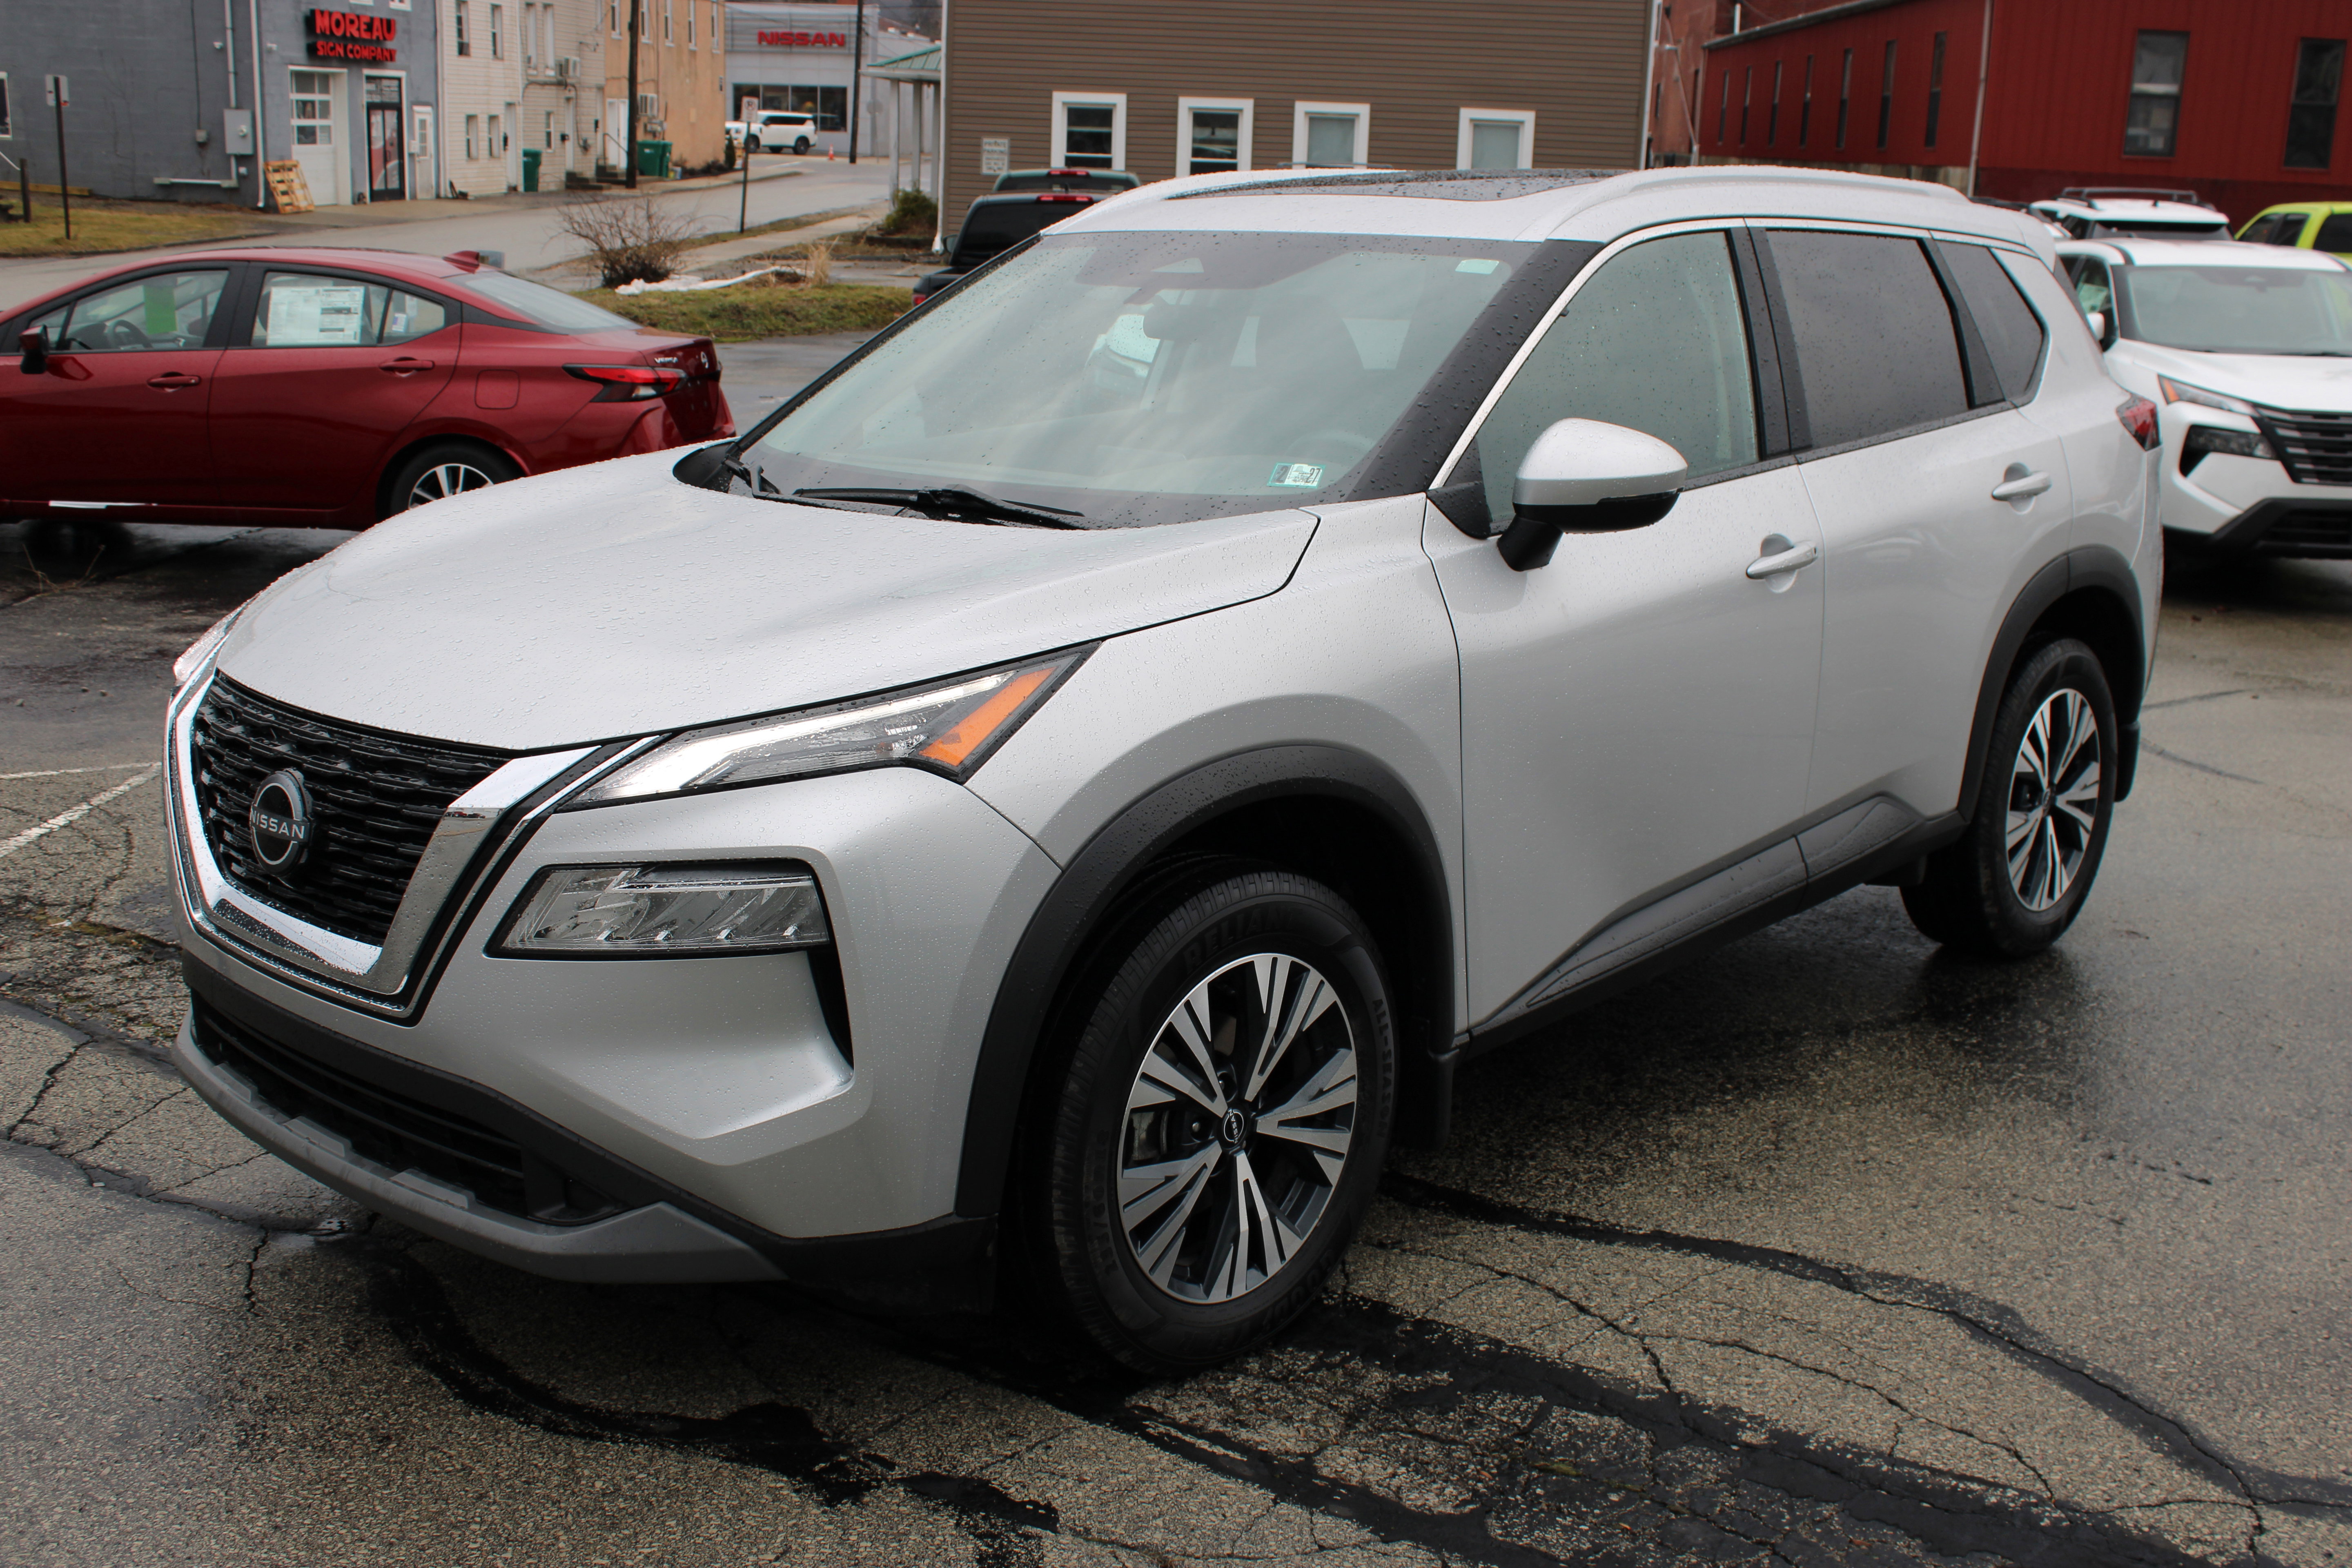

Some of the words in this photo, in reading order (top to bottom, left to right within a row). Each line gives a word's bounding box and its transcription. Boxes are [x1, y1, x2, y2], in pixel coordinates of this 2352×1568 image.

[315, 9, 396, 40] MOREAU
[757, 30, 845, 46] NISSAN
[316, 40, 344, 57] SIGN
[346, 43, 397, 62] COMPANY
[1276, 466, 1289, 483] 2
[1306, 468, 1321, 483] 27
[250, 809, 305, 839] NISSAN
[1182, 906, 1303, 975] RELIANT
[1372, 996, 1392, 1138] ALL-SEASON
[1228, 1108, 1238, 1144] NISSAN
